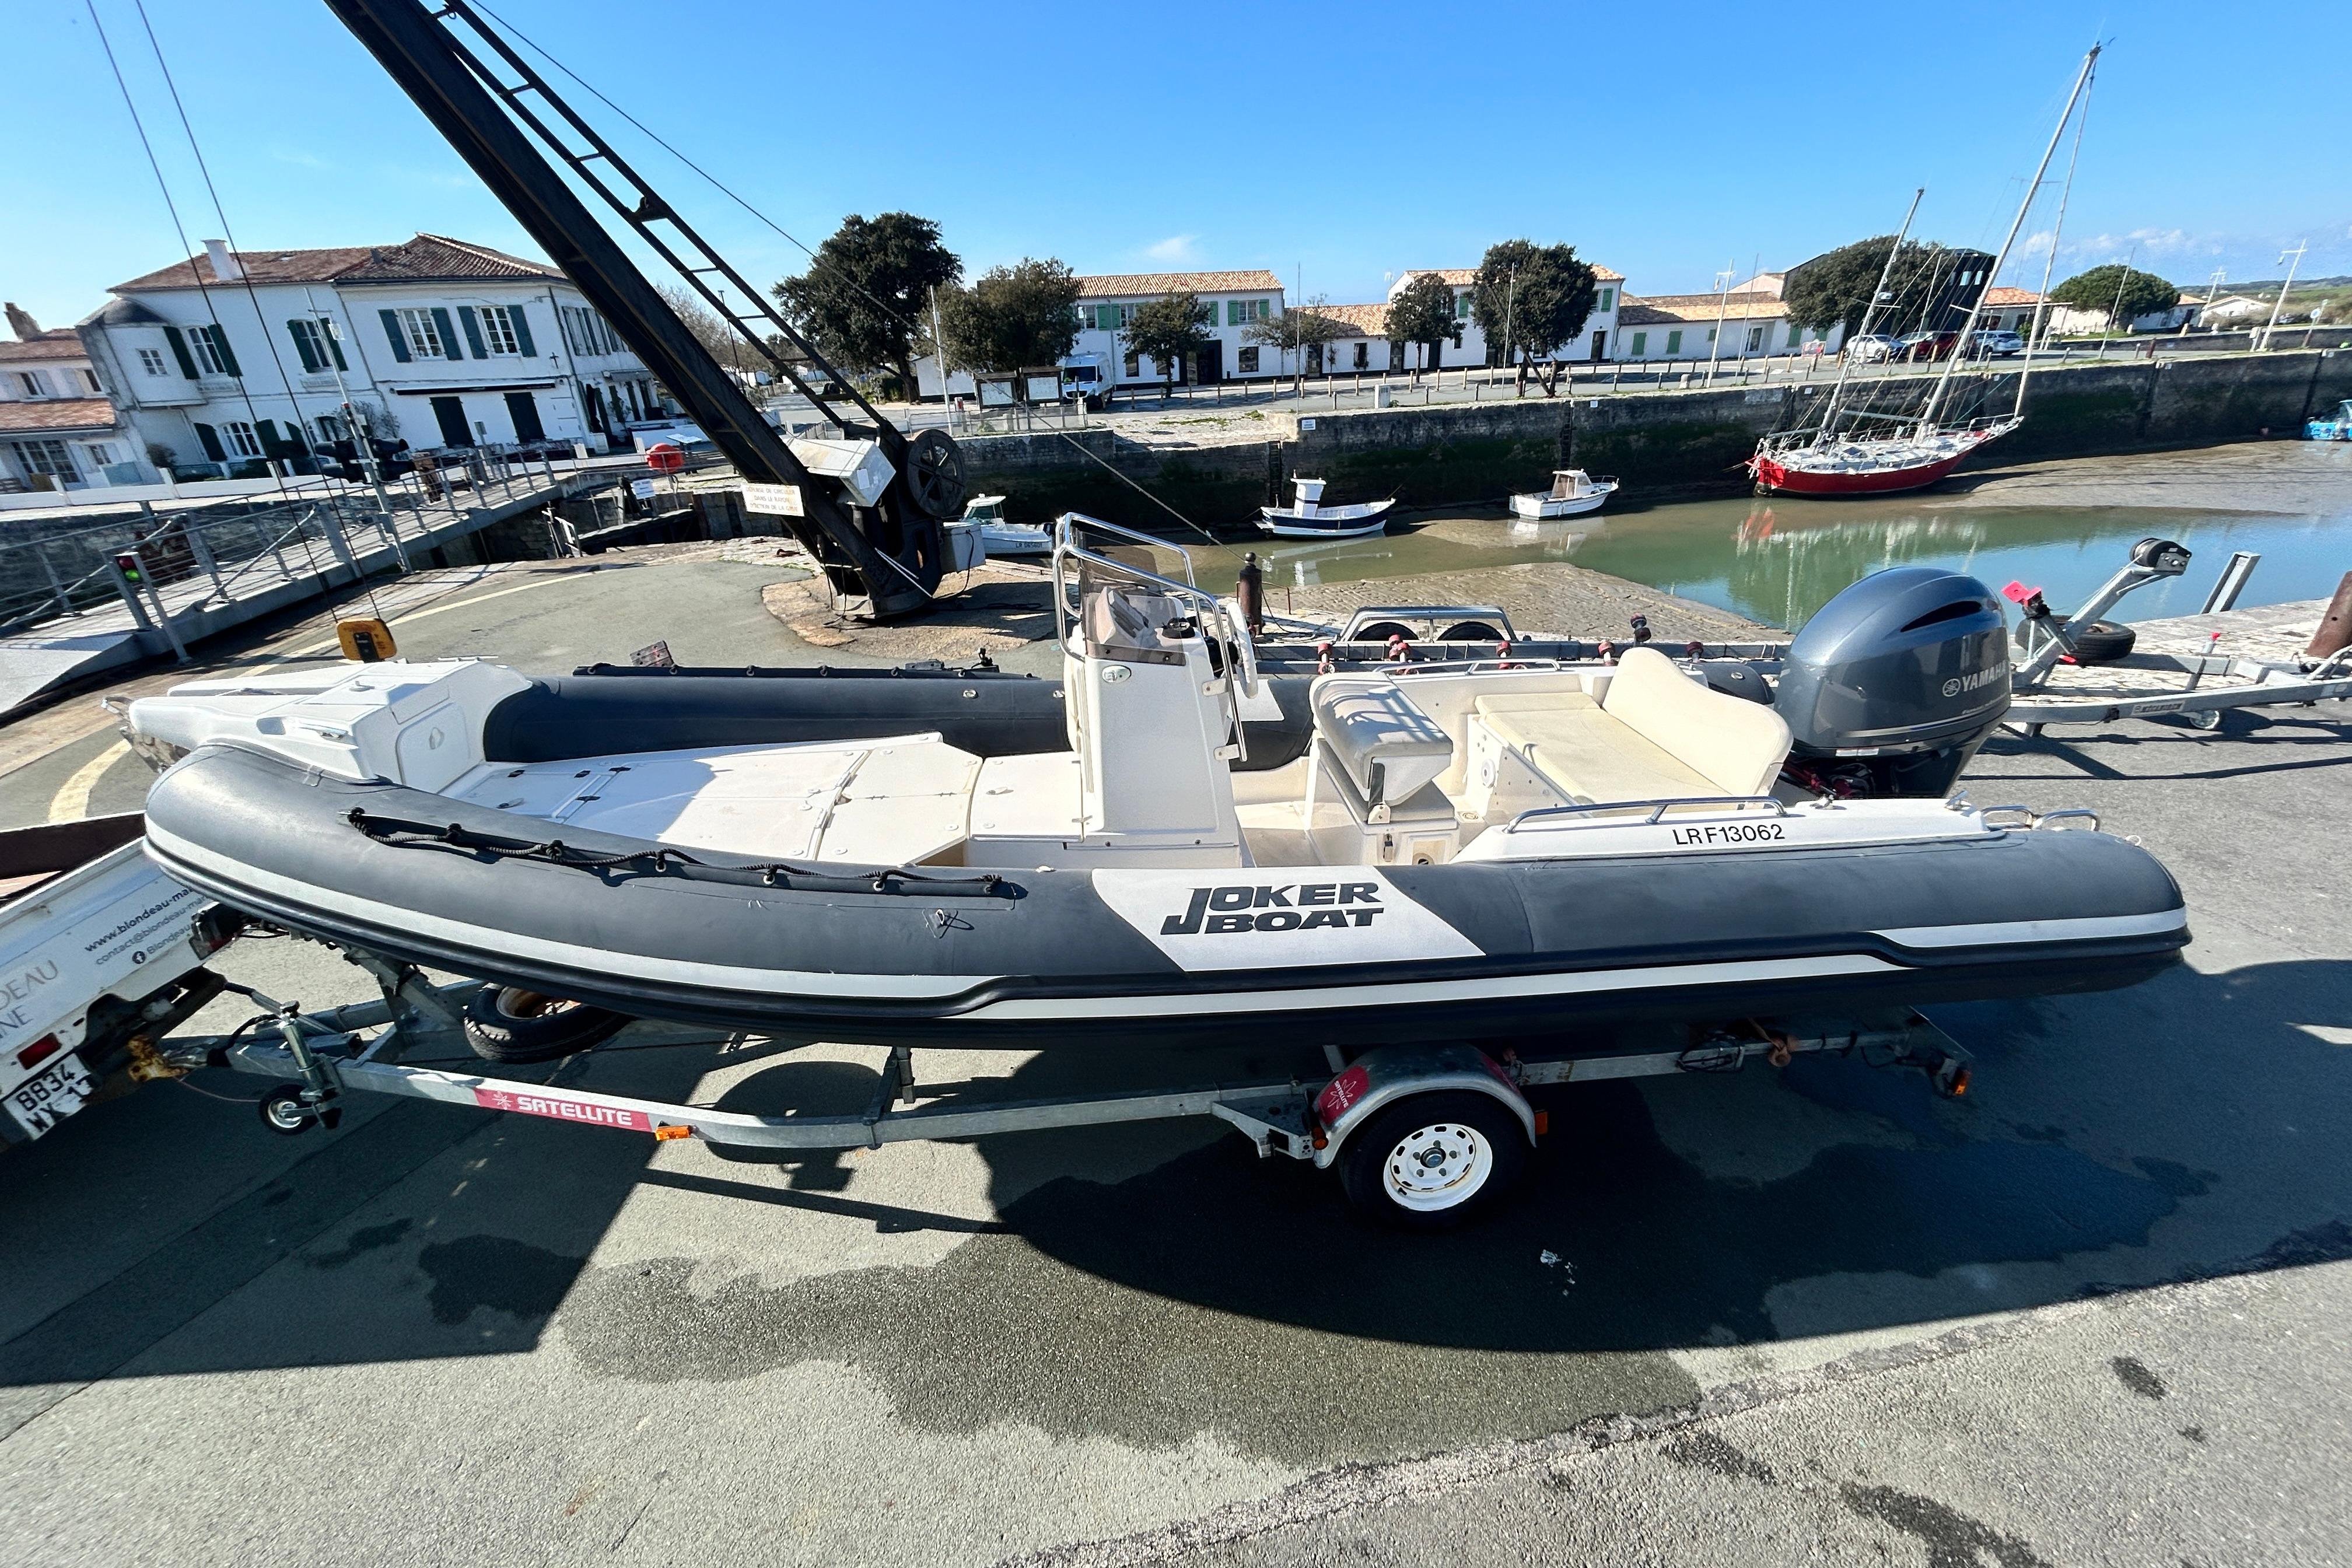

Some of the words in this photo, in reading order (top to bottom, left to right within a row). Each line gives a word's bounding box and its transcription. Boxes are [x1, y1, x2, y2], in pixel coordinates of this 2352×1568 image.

[1962, 660, 2006, 692] YAMAHA
[1160, 882, 1383, 935] JOKER
[1204, 907, 1385, 935] BOAT
[16, 1063, 75, 1112] 8834
[516, 1096, 633, 1126] SATELLITE
